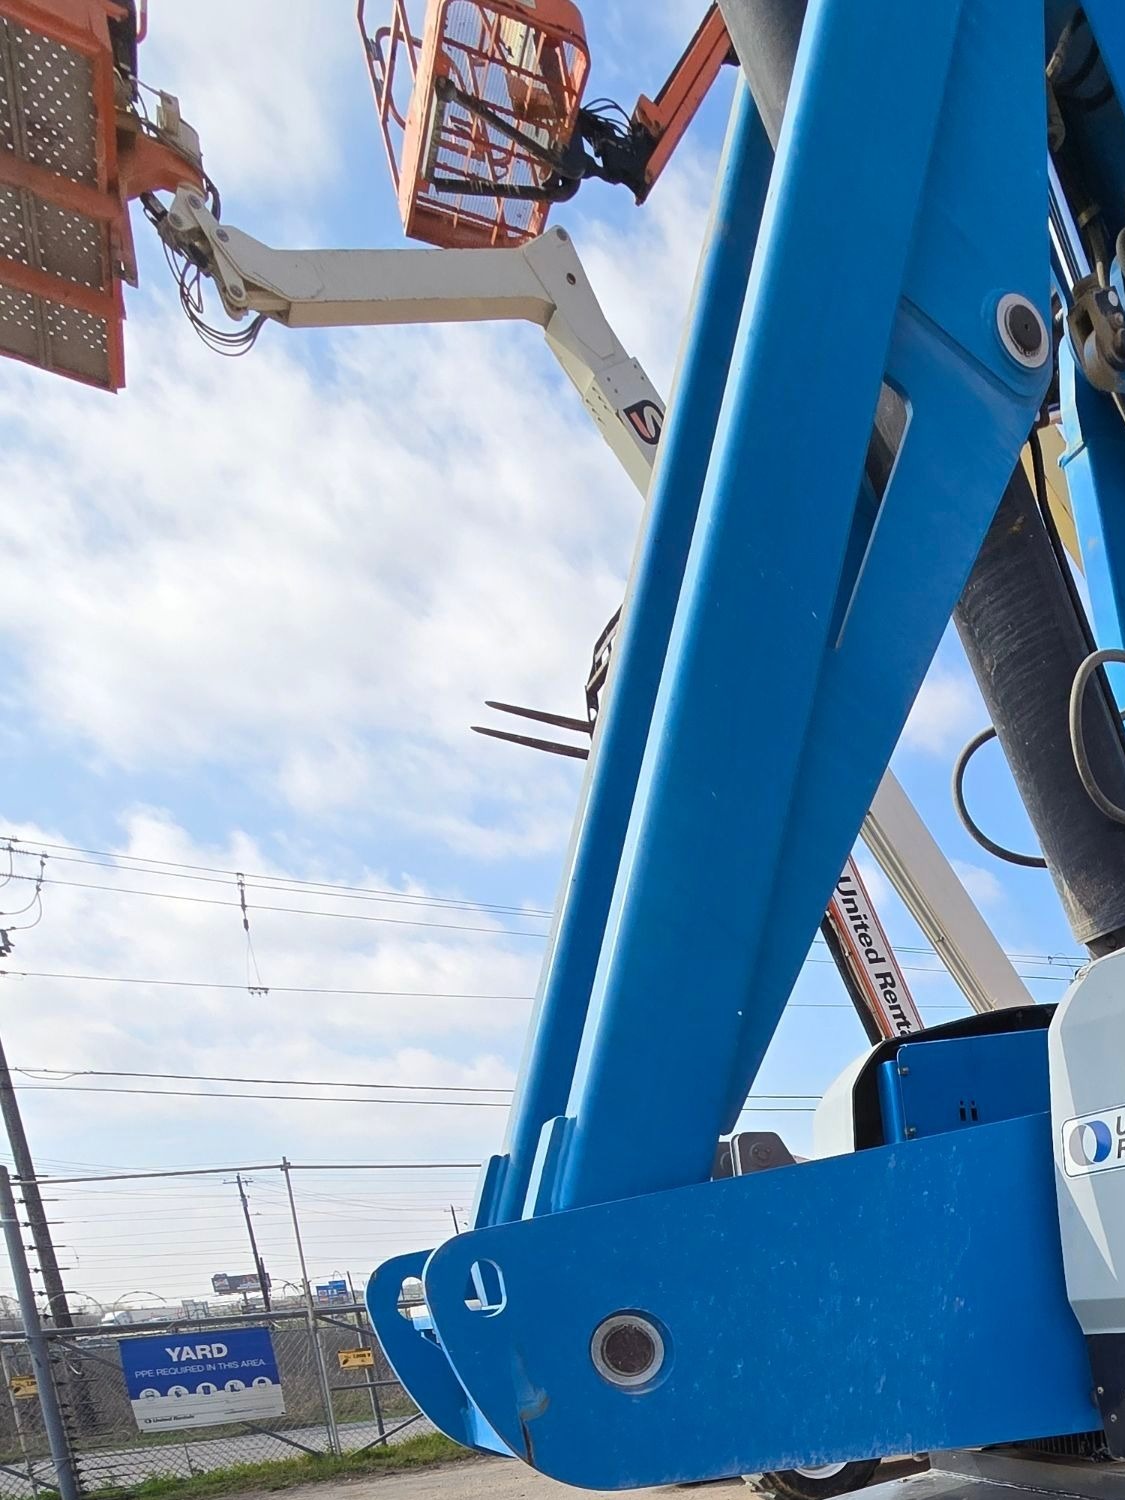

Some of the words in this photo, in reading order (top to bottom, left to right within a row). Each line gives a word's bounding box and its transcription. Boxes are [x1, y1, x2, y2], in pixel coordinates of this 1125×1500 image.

[836, 876, 886, 965] United
[165, 1343, 228, 1362] YARD
[135, 1370, 155, 1379] PPE
[156, 1364, 205, 1377] REQUIRED
[207, 1363, 217, 1372] IN
[219, 1361, 240, 1370] THIS
[240, 1358, 266, 1367] AREA
